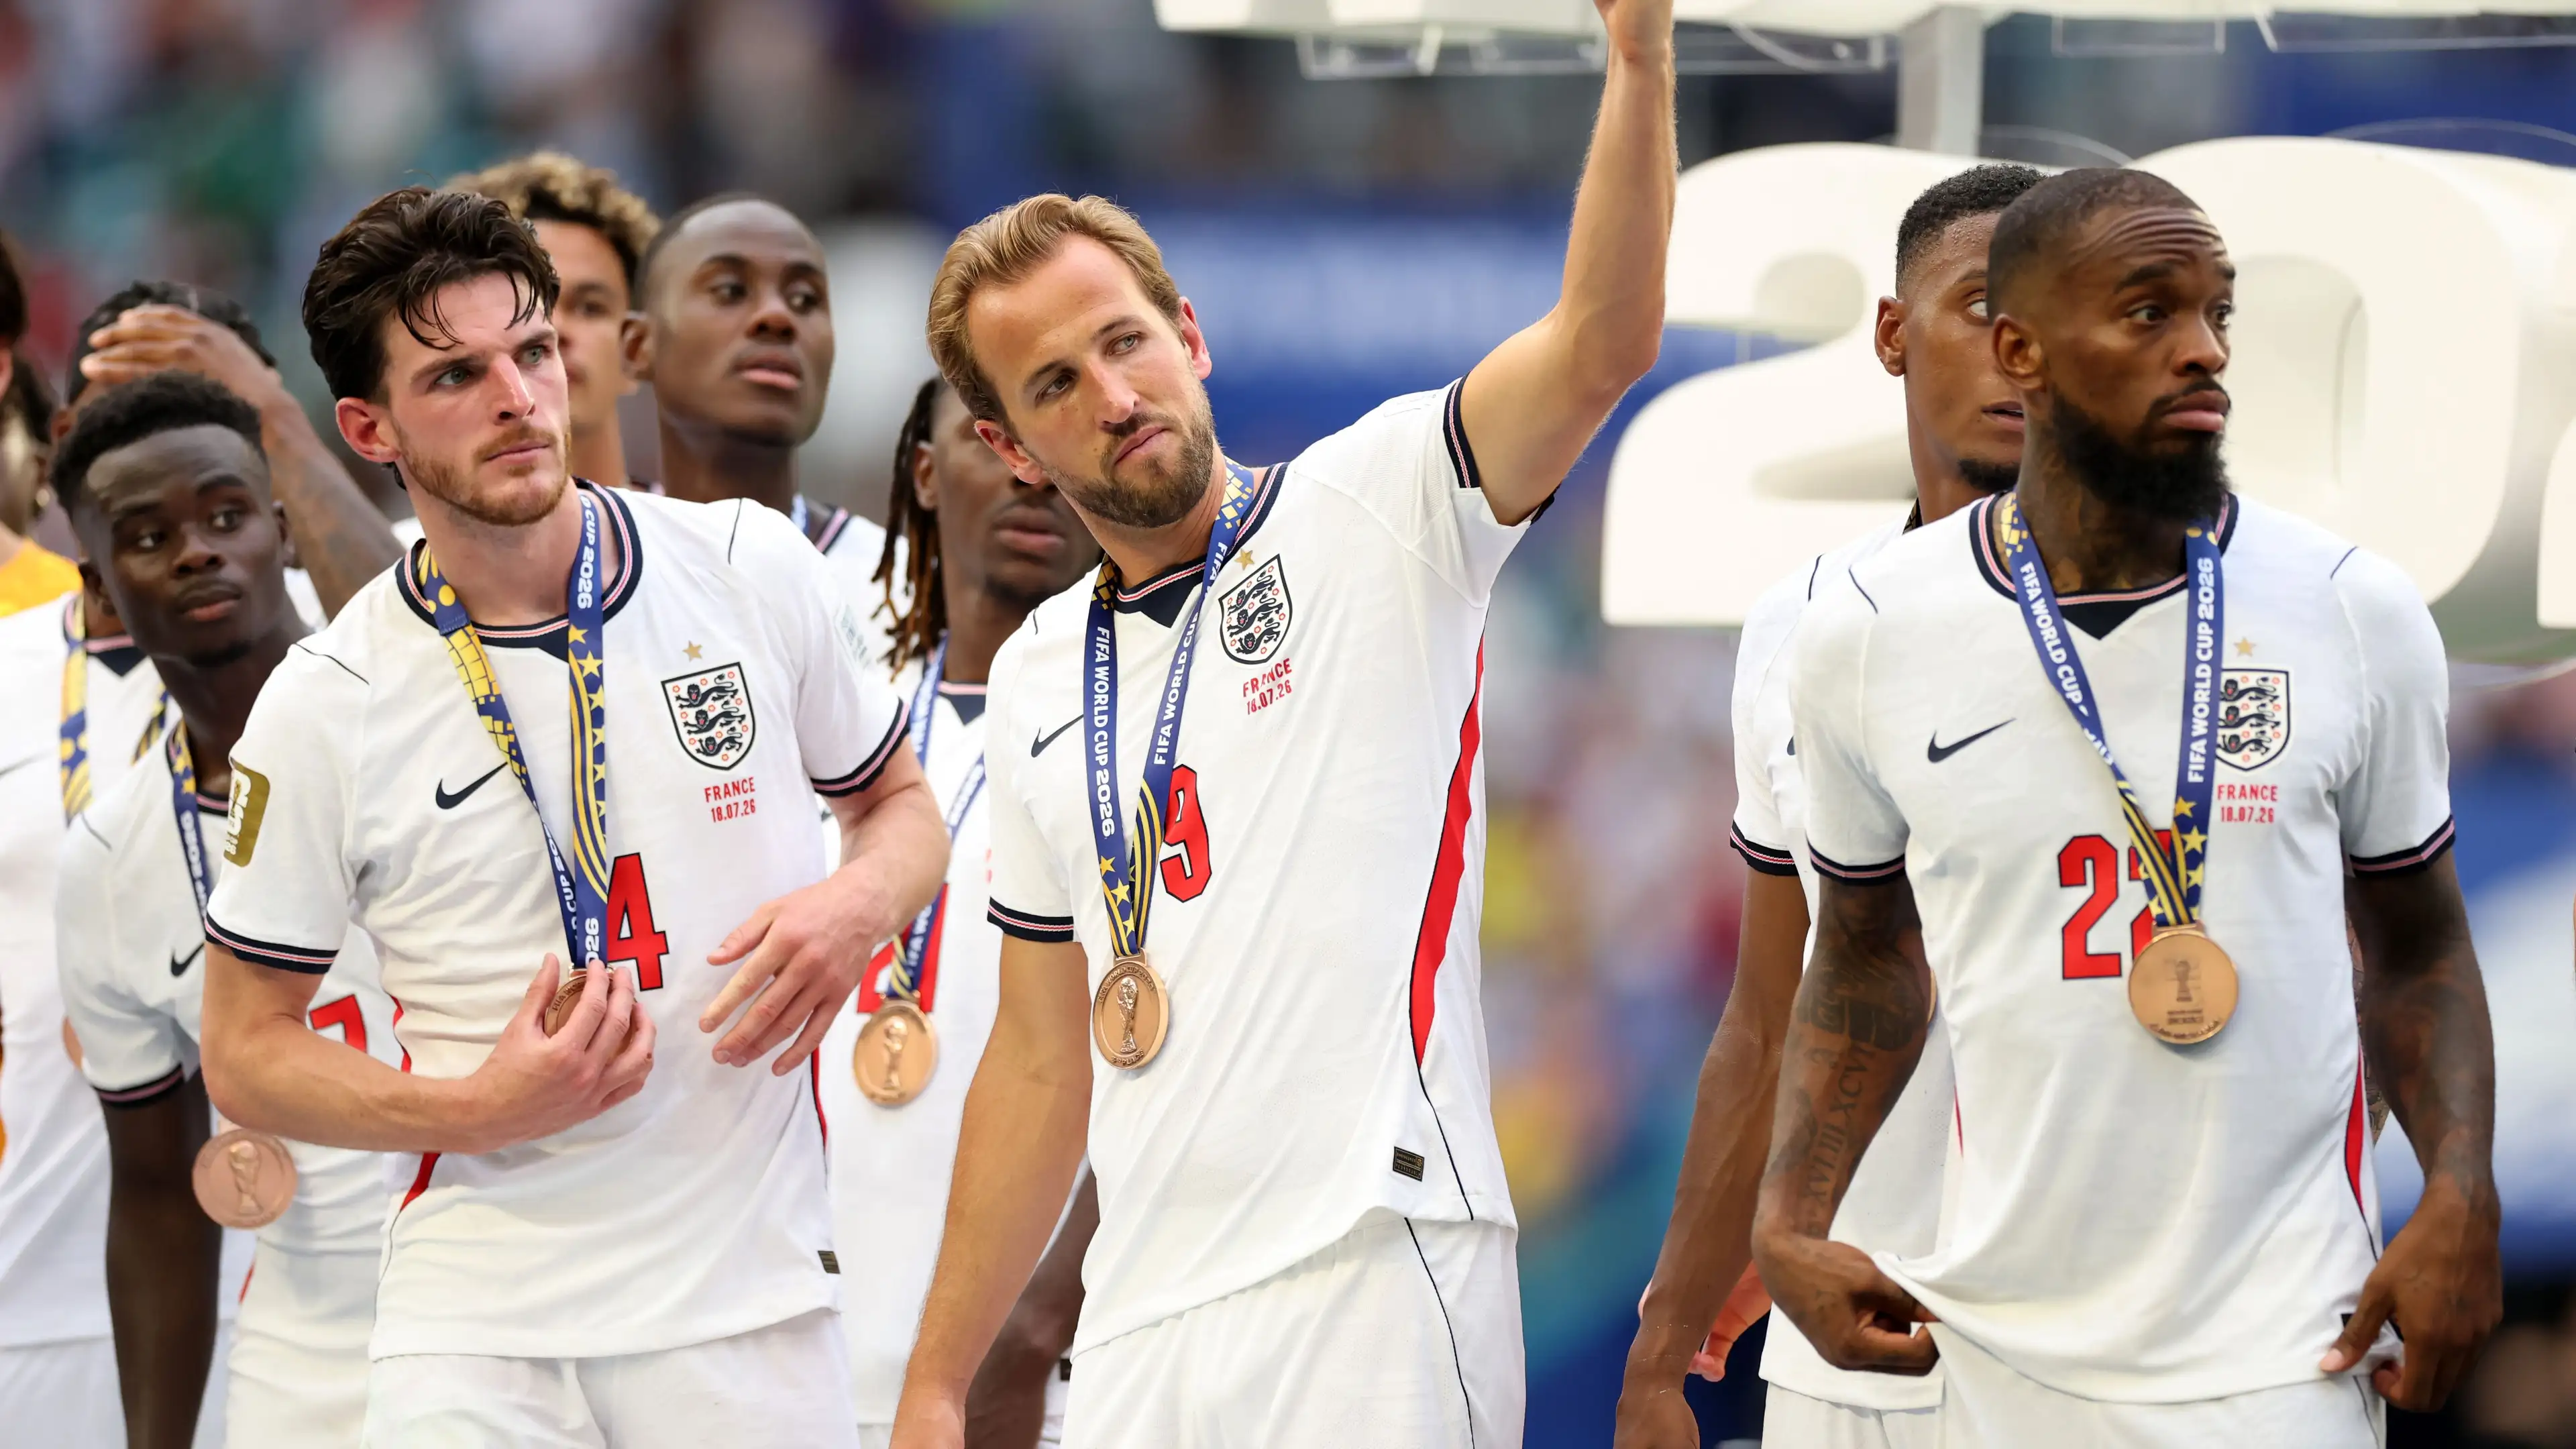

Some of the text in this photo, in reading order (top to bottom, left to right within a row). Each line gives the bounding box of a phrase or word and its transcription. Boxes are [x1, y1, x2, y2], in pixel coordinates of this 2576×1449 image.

[585, 509, 596, 545] CUP
[578, 546, 594, 609] 2026
[1210, 542, 1228, 580] FIFA
[2021, 561, 2083, 704] FIFA WORLD CUP
[1163, 651, 1187, 720] WORLD
[2188, 557, 2214, 783] FIFA WORLD CUP 2026
[1093, 627, 1115, 837] FIFA WORLD CUP 2026
[1154, 723, 1173, 765] FIFA
[704, 776, 755, 803] FRANCE
[711, 798, 756, 822] 18.07.26
[2217, 784, 2278, 801] FRANCE
[1160, 763, 1212, 903] 9
[559, 875, 577, 913] CUP
[607, 853, 669, 991] 4
